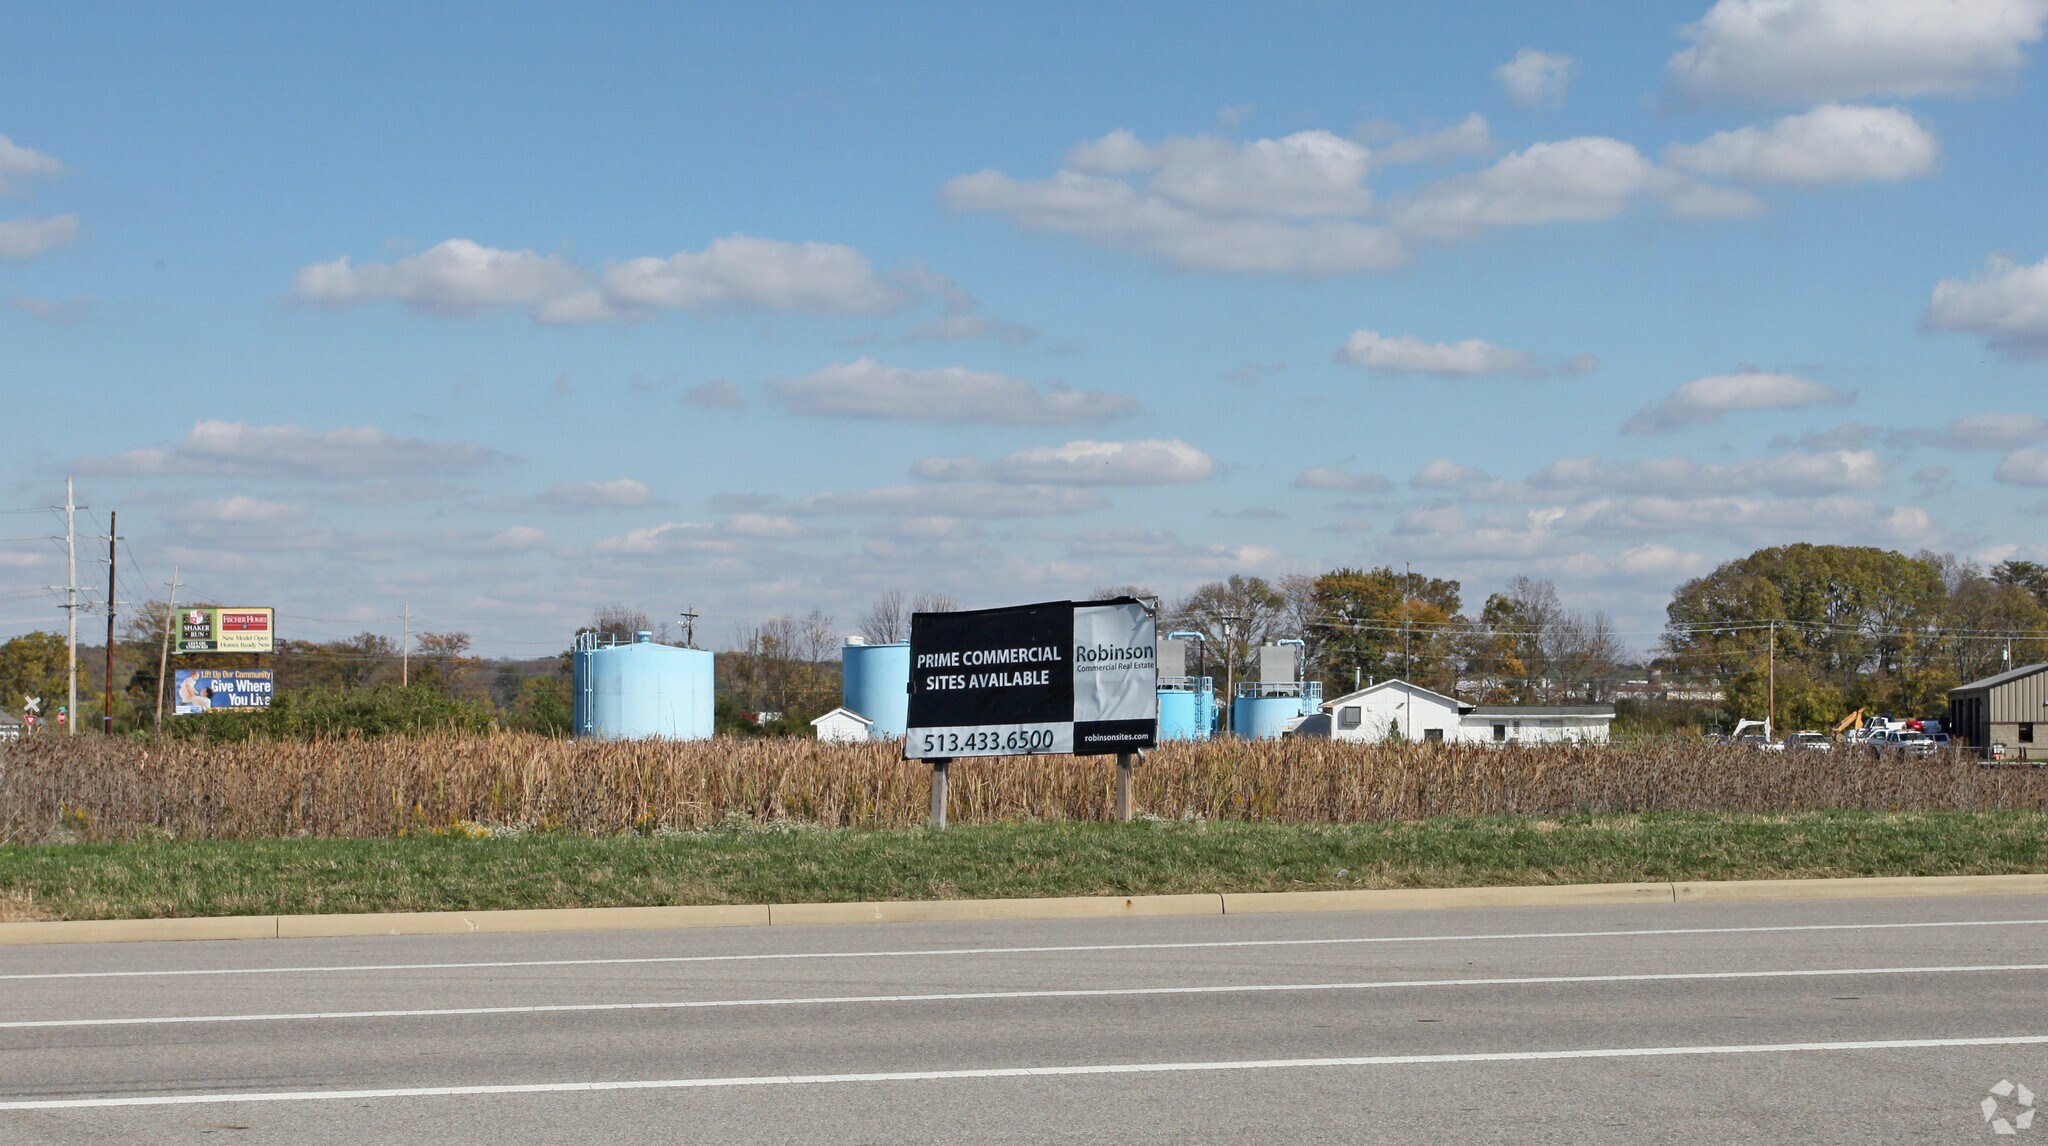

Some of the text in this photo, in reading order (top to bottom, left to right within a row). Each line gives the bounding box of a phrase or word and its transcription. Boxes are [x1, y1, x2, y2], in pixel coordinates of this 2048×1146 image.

[917, 646, 1061, 668] PRIME COMMERCIAL
[1076, 644, 1154, 662] Robinson
[1076, 661, 1154, 672] Commercial Real Estate
[201, 670, 212, 678] Lift
[212, 671, 221, 680] Up
[235, 670, 270, 680] Community
[926, 670, 1050, 690] SITES AVAILABLE
[211, 679, 271, 692] Give Where
[228, 693, 248, 706] You
[923, 729, 1054, 752] 513.433.6500
[1084, 732, 1149, 742] robinsonsites.com
